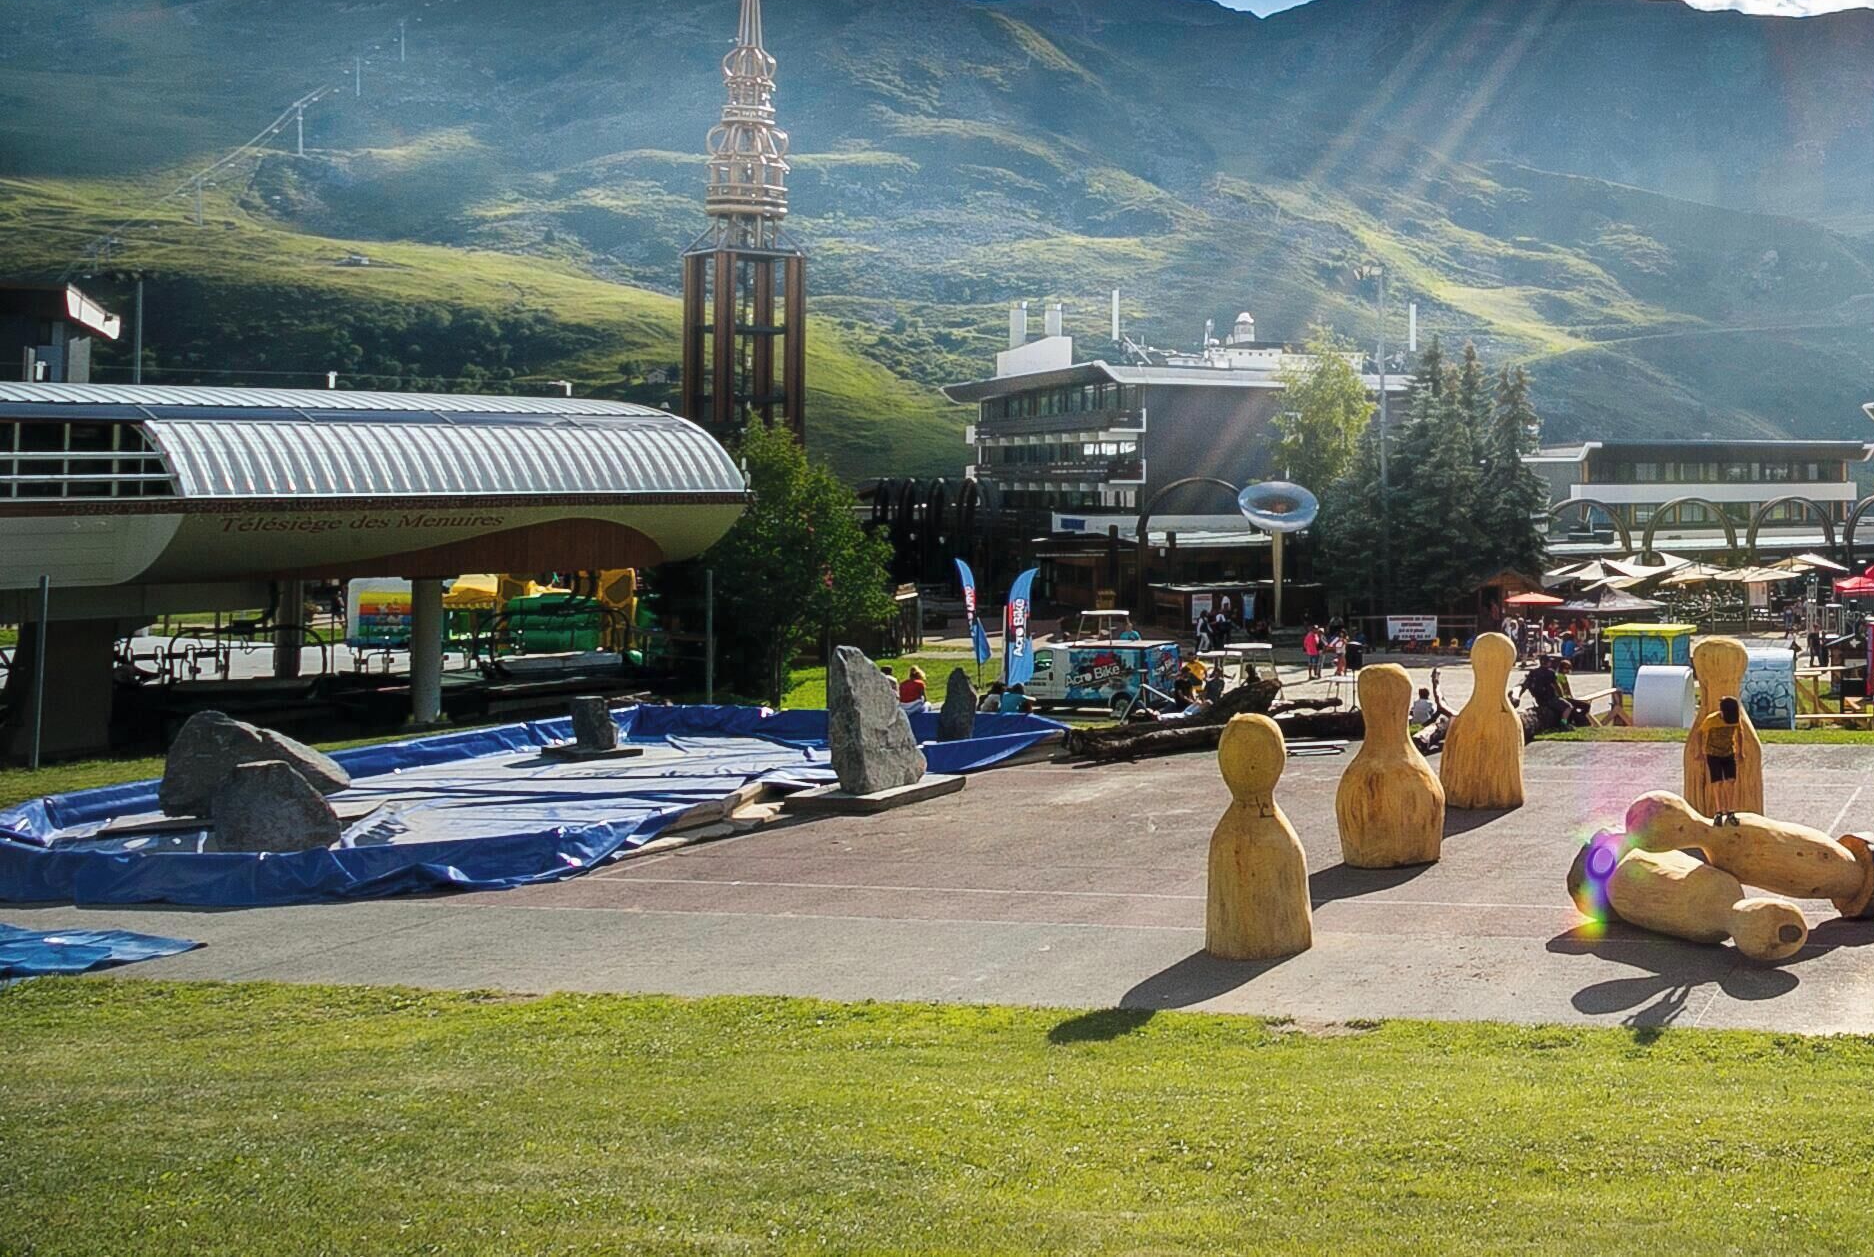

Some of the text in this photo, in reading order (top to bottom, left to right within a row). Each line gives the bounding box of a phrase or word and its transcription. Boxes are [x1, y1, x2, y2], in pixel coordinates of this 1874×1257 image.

[220, 513, 505, 534] Télésiège des Menuires
[1012, 598, 1025, 657] Acro Bike
[1065, 663, 1120, 686] Acro Bike
